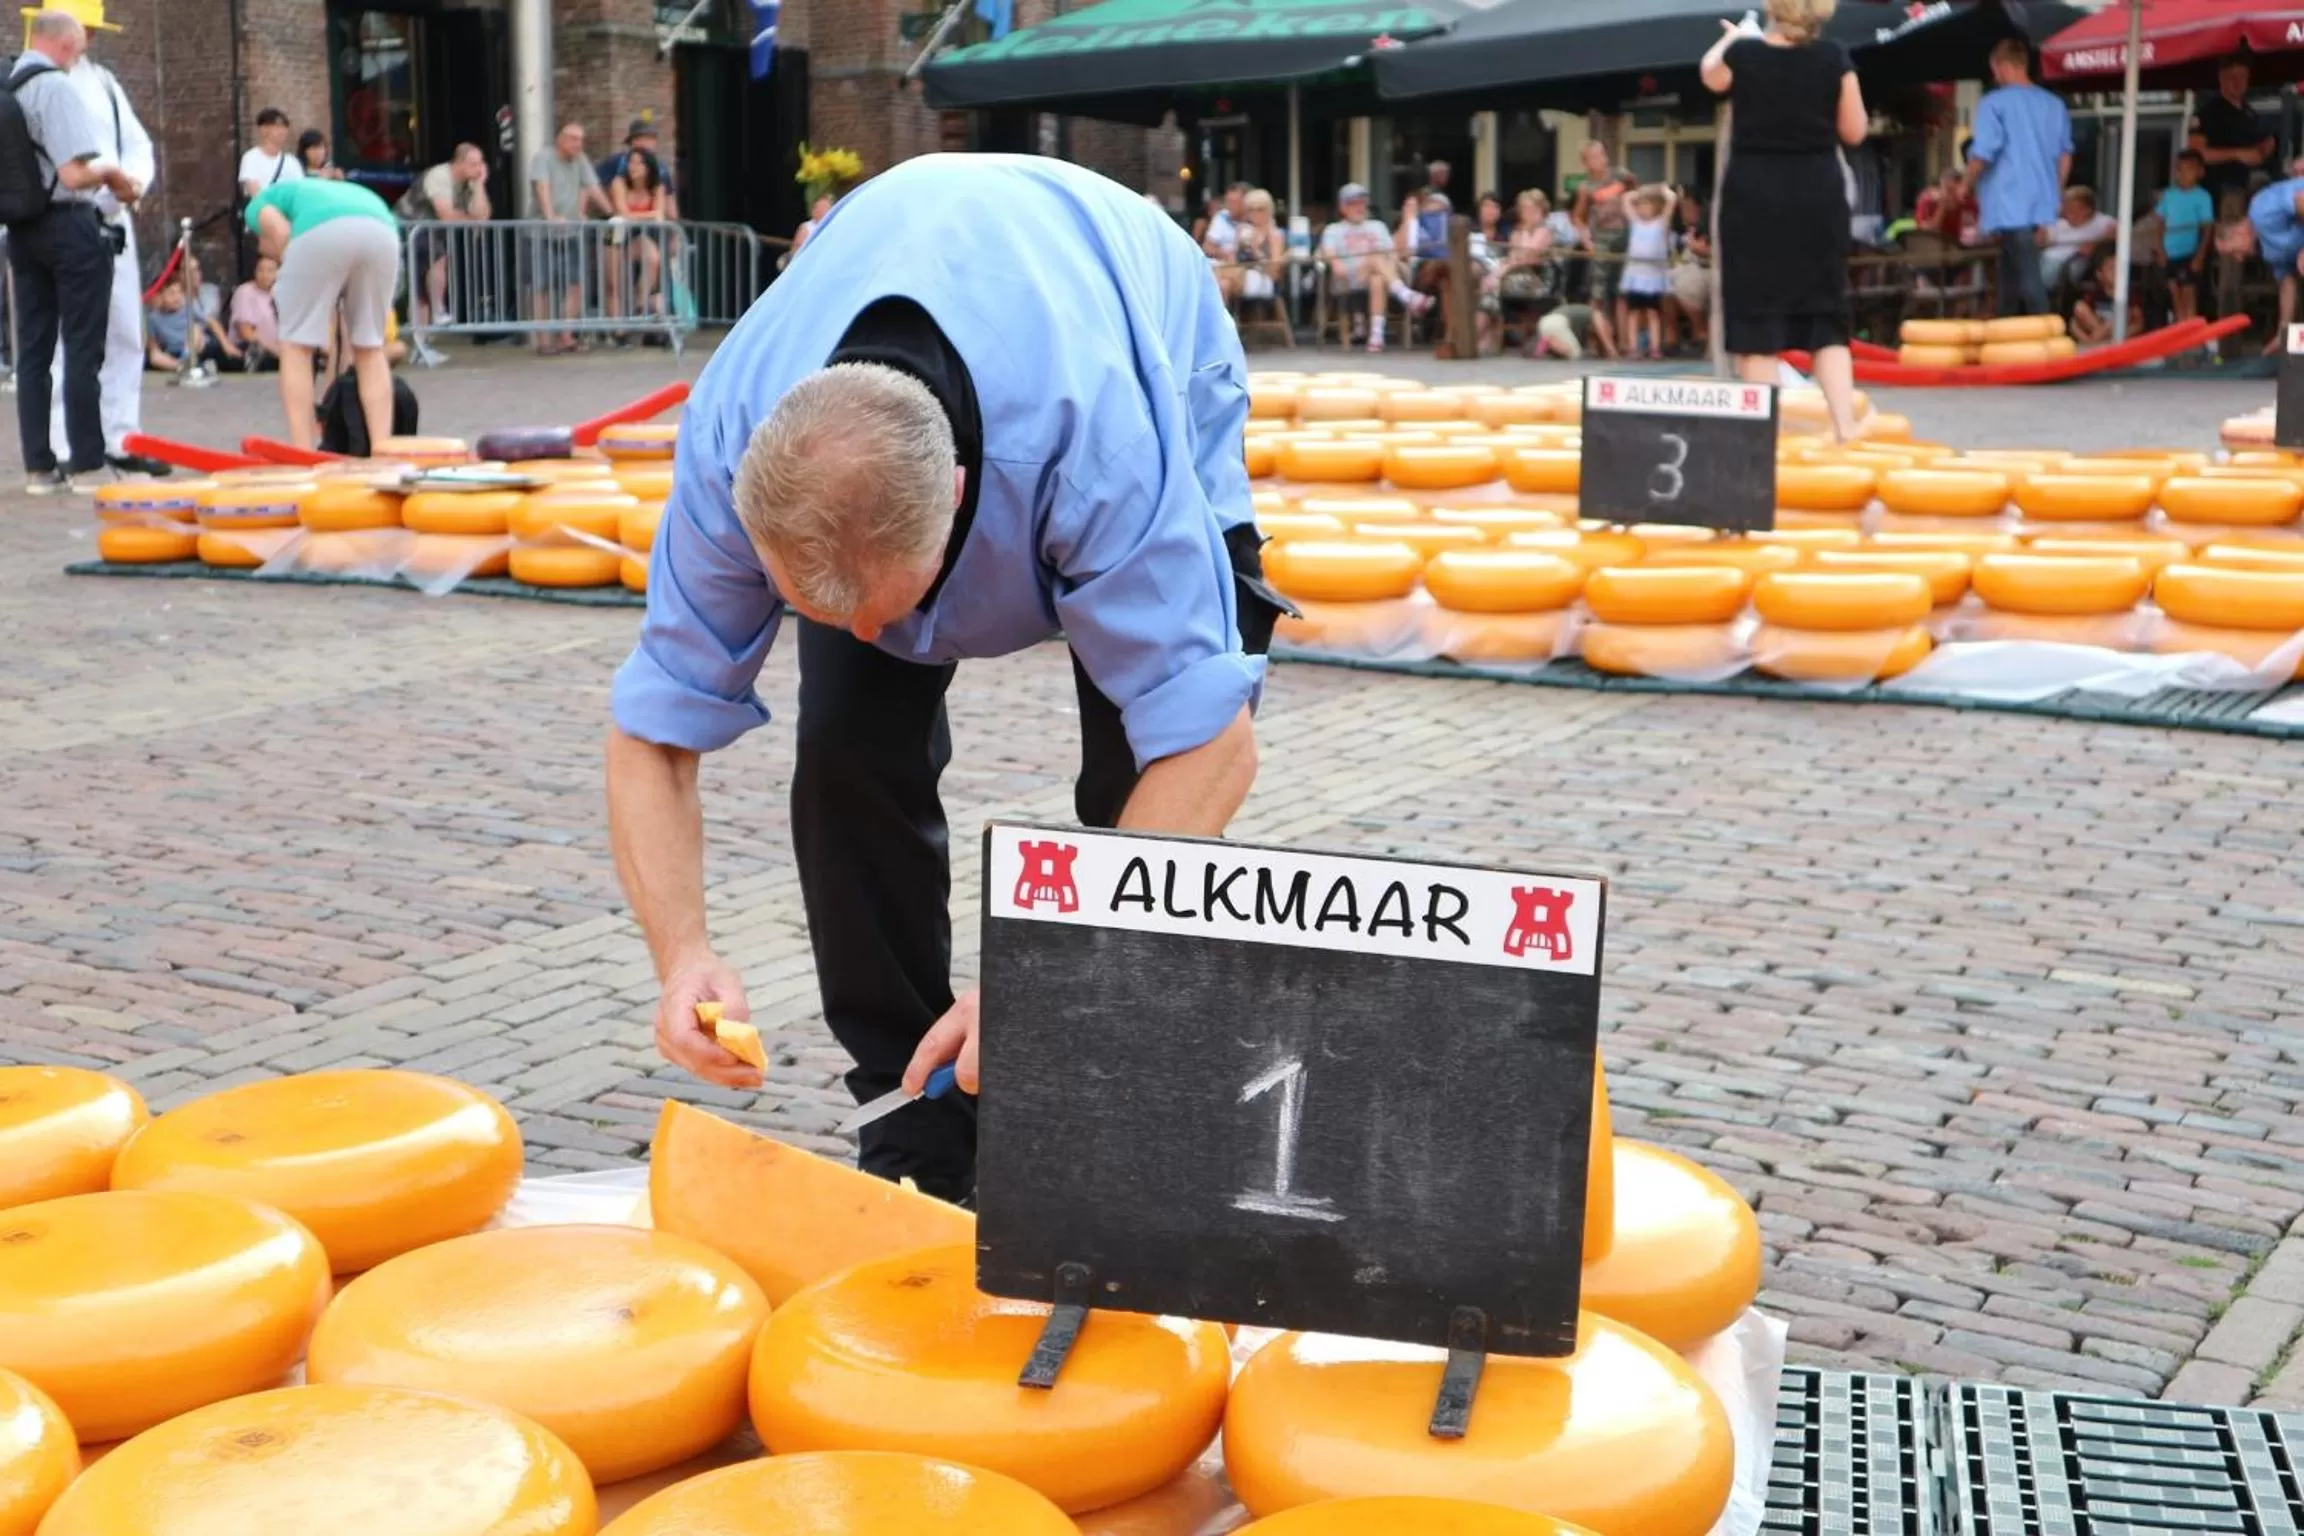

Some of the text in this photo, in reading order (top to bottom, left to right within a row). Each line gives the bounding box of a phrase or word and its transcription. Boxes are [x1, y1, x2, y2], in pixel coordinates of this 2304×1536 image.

[1625, 384, 1732, 408] ALKMAAR
[1649, 432, 1688, 500] 3
[1109, 856, 1471, 945] ALKMAAR
[1229, 1054, 1347, 1222] 1
